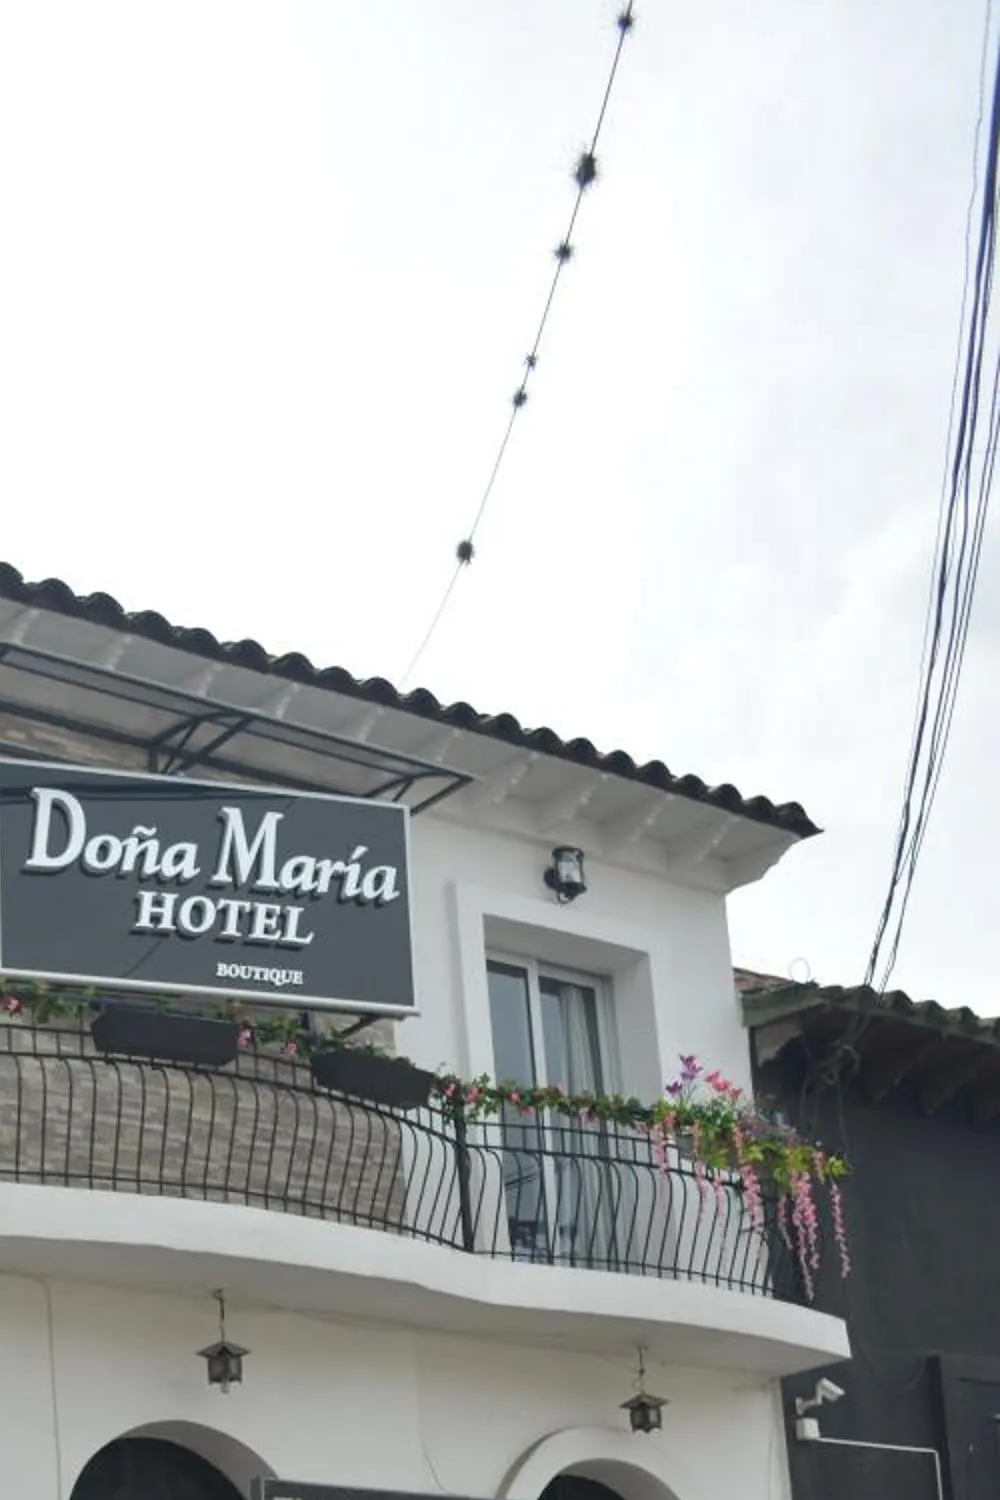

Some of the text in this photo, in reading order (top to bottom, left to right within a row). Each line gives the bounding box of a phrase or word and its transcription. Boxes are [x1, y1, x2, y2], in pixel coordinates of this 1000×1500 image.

[25, 786, 400, 901] Doña María
[135, 890, 314, 945] HOTEL
[216, 962, 304, 986] BOUTIQUE
